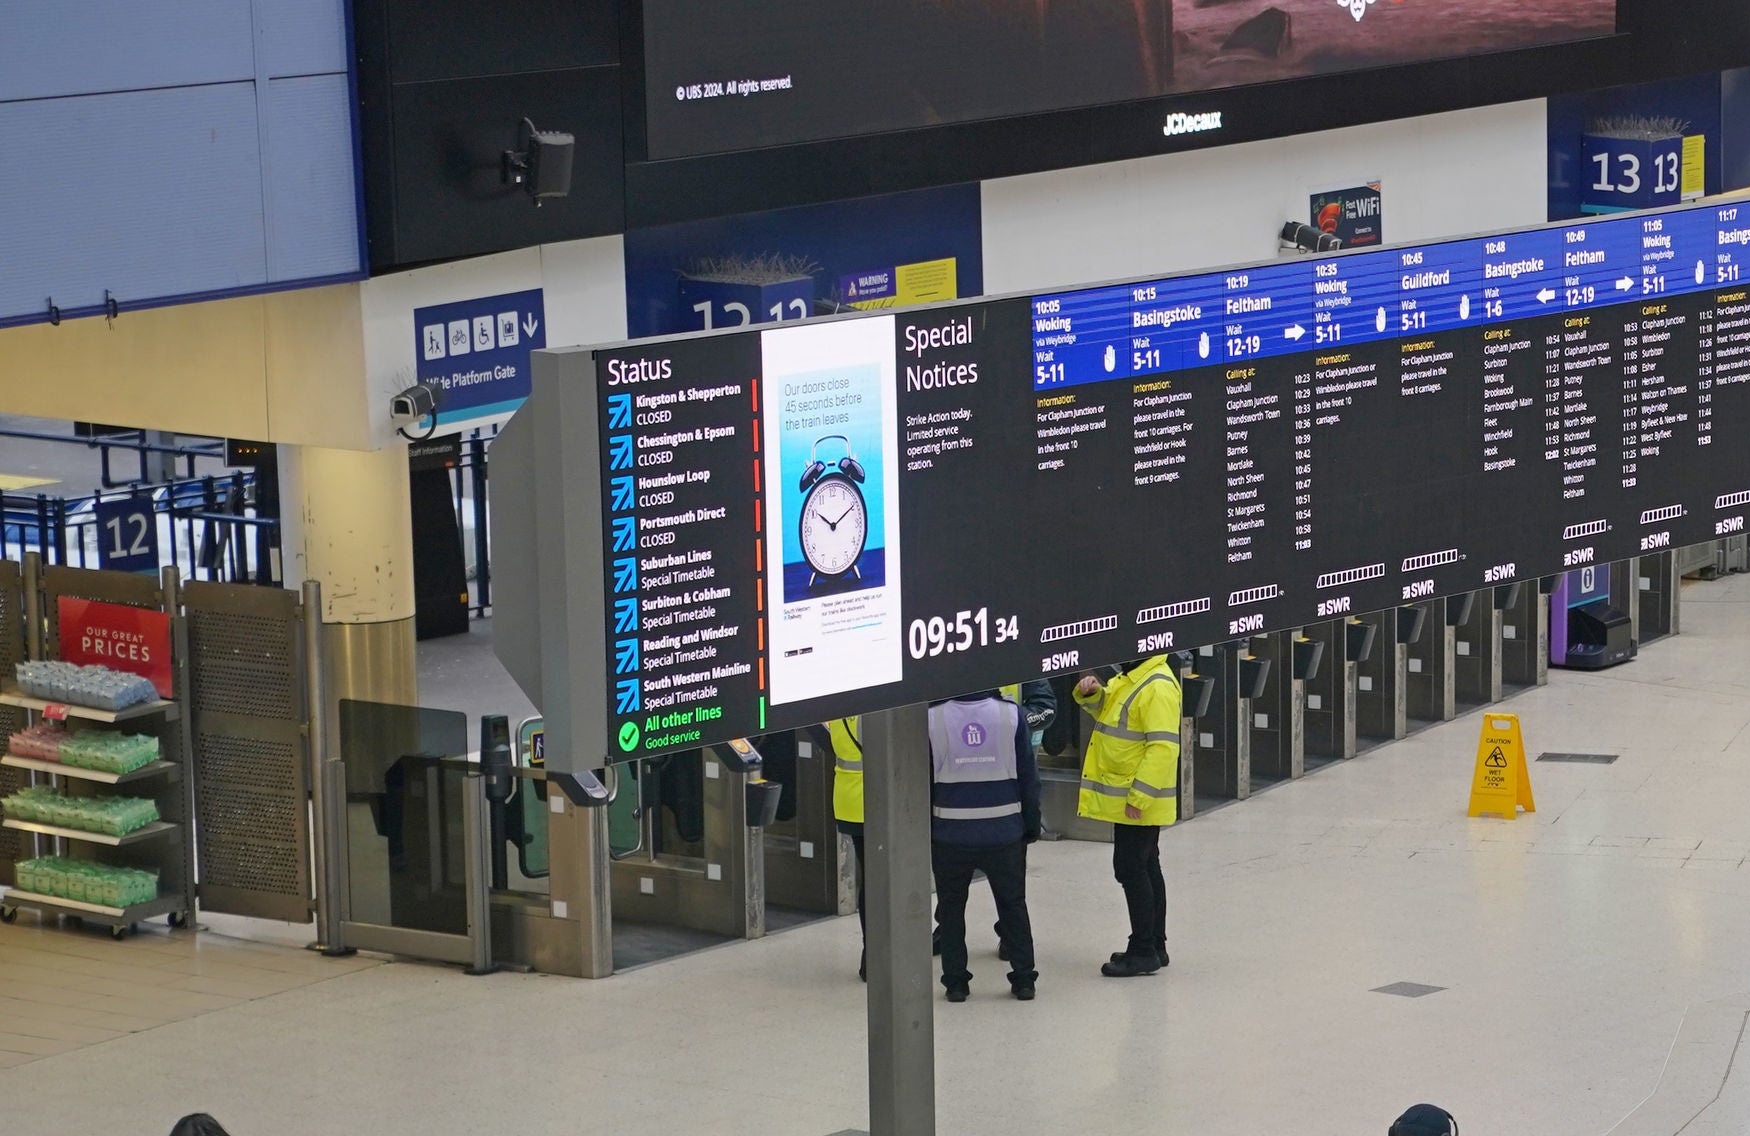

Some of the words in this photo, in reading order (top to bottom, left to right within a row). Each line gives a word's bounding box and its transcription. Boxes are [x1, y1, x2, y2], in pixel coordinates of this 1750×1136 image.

[686, 84, 702, 100] UBS
[703, 83, 724, 98] 2024.
[726, 81, 737, 95] All
[738, 79, 759, 97] rights
[760, 75, 793, 91] reserved.
[1163, 111, 1222, 136] JCDecaux
[1592, 152, 1640, 193] 13
[1654, 151, 1678, 194] 13
[1356, 197, 1380, 218] WiFi
[1718, 209, 1737, 222] 11:17
[1644, 219, 1662, 232] 11:05
[1566, 230, 1585, 243] 10:49
[1643, 234, 1671, 249] Woking
[1485, 241, 1505, 254] 10:48
[1402, 252, 1423, 266] 10:45
[1485, 258, 1544, 279] Basingstoke
[1565, 250, 1604, 267] Feltham
[859, 273, 889, 286] WARNING
[1316, 264, 1337, 278] 10:35
[1402, 270, 1450, 290] Guildford
[1717, 265, 1739, 283] 5-11
[1226, 275, 1248, 289] 10:19
[1315, 279, 1347, 295] Woking
[1642, 276, 1665, 295] 5-11
[1133, 287, 1156, 302] 10:15
[1565, 287, 1595, 306] 12-19
[1036, 300, 1060, 315] 10:05
[1226, 296, 1271, 315] Feltham
[1485, 300, 1502, 318] 1-6
[1036, 317, 1071, 333] Woking
[1134, 305, 1201, 328] Basingstoke
[1401, 311, 1426, 331] 5-11
[905, 316, 972, 358] Special
[1316, 324, 1341, 343] 5-11
[1227, 335, 1260, 356] 12-19
[1134, 349, 1160, 370] 5-11
[452, 370, 492, 389] Platform
[494, 365, 516, 380] Gate
[608, 358, 672, 386] Status
[906, 361, 978, 392] Notices
[1036, 363, 1064, 385] 5-11
[636, 392, 677, 409] Kingston
[679, 390, 686, 402] &
[687, 384, 741, 403] Shepperton
[784, 383, 800, 396] Our
[802, 381, 826, 394] doors
[828, 377, 850, 390] close
[785, 400, 797, 413] 45
[798, 396, 834, 412] seconds
[835, 393, 862, 407] before
[637, 410, 672, 426] CLOSED
[785, 418, 800, 431] the
[801, 416, 821, 428] train
[823, 412, 850, 425] leaves
[906, 413, 927, 427] Strike
[927, 410, 950, 423] Action
[951, 407, 973, 422] today.
[637, 431, 694, 449] Chessington
[695, 429, 703, 440] &
[704, 426, 735, 442] Epsom
[907, 427, 934, 442] Limited
[934, 424, 959, 437] service
[421, 443, 453, 455] Information
[907, 441, 941, 458] operating
[941, 438, 959, 451] from
[959, 436, 974, 449] this
[638, 451, 673, 467] CLOSED
[907, 459, 933, 471] station.
[639, 472, 685, 489] Hounslow
[687, 469, 710, 483] Loop
[639, 491, 674, 507] CLOSED
[640, 511, 695, 530] Portsmouth
[697, 506, 726, 521] Direct
[106, 512, 149, 560] 12
[640, 532, 675, 548] CLOSED
[641, 554, 686, 570] Suburban
[688, 550, 712, 564] Lines
[641, 572, 671, 590] Special
[673, 566, 715, 583] Timetable
[642, 594, 682, 611] Surbiton
[683, 592, 691, 604] &
[692, 587, 731, 603] Cobham
[642, 613, 672, 631] Special
[673, 606, 716, 624] Timetable
[86, 626, 107, 638] OUR
[112, 630, 144, 645] GREAT
[644, 634, 681, 651] Reading
[682, 630, 699, 644] and
[700, 625, 739, 641] Windsor
[908, 607, 988, 660] 09:51
[995, 615, 1018, 643] 34
[82, 636, 151, 662] PRICES
[644, 654, 673, 671] Special
[675, 646, 717, 664] Timetable
[644, 674, 671, 692] South
[672, 669, 710, 687] Western
[712, 662, 751, 679] Mainline
[644, 693, 674, 712] Special
[676, 685, 717, 704] Timetable
[645, 715, 660, 732] All
[662, 709, 693, 728] other
[696, 706, 722, 722] lines
[645, 735, 670, 750] Good
[671, 729, 700, 744] service
